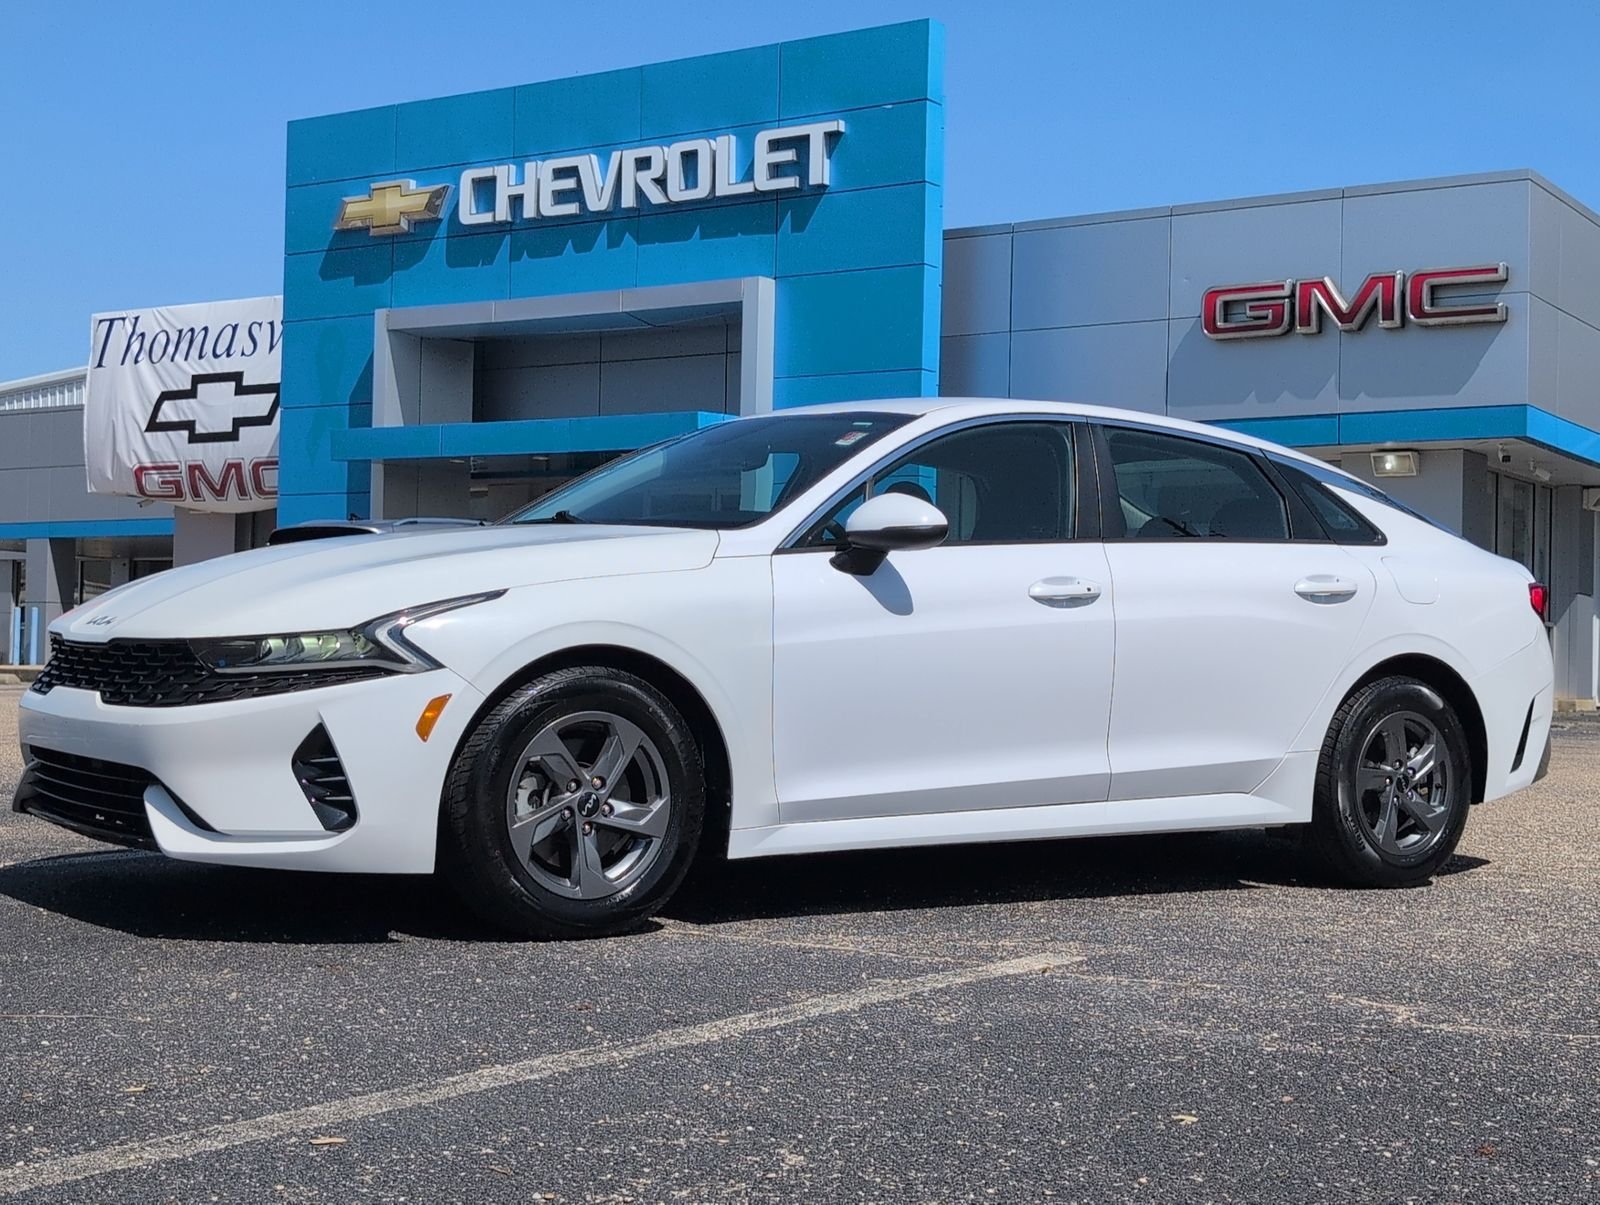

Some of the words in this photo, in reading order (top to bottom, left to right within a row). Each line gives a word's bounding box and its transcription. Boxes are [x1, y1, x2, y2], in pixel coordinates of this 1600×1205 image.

[458, 119, 845, 225] CHEVROLET
[1201, 262, 1509, 341] GMC
[132, 457, 279, 502] GMC
